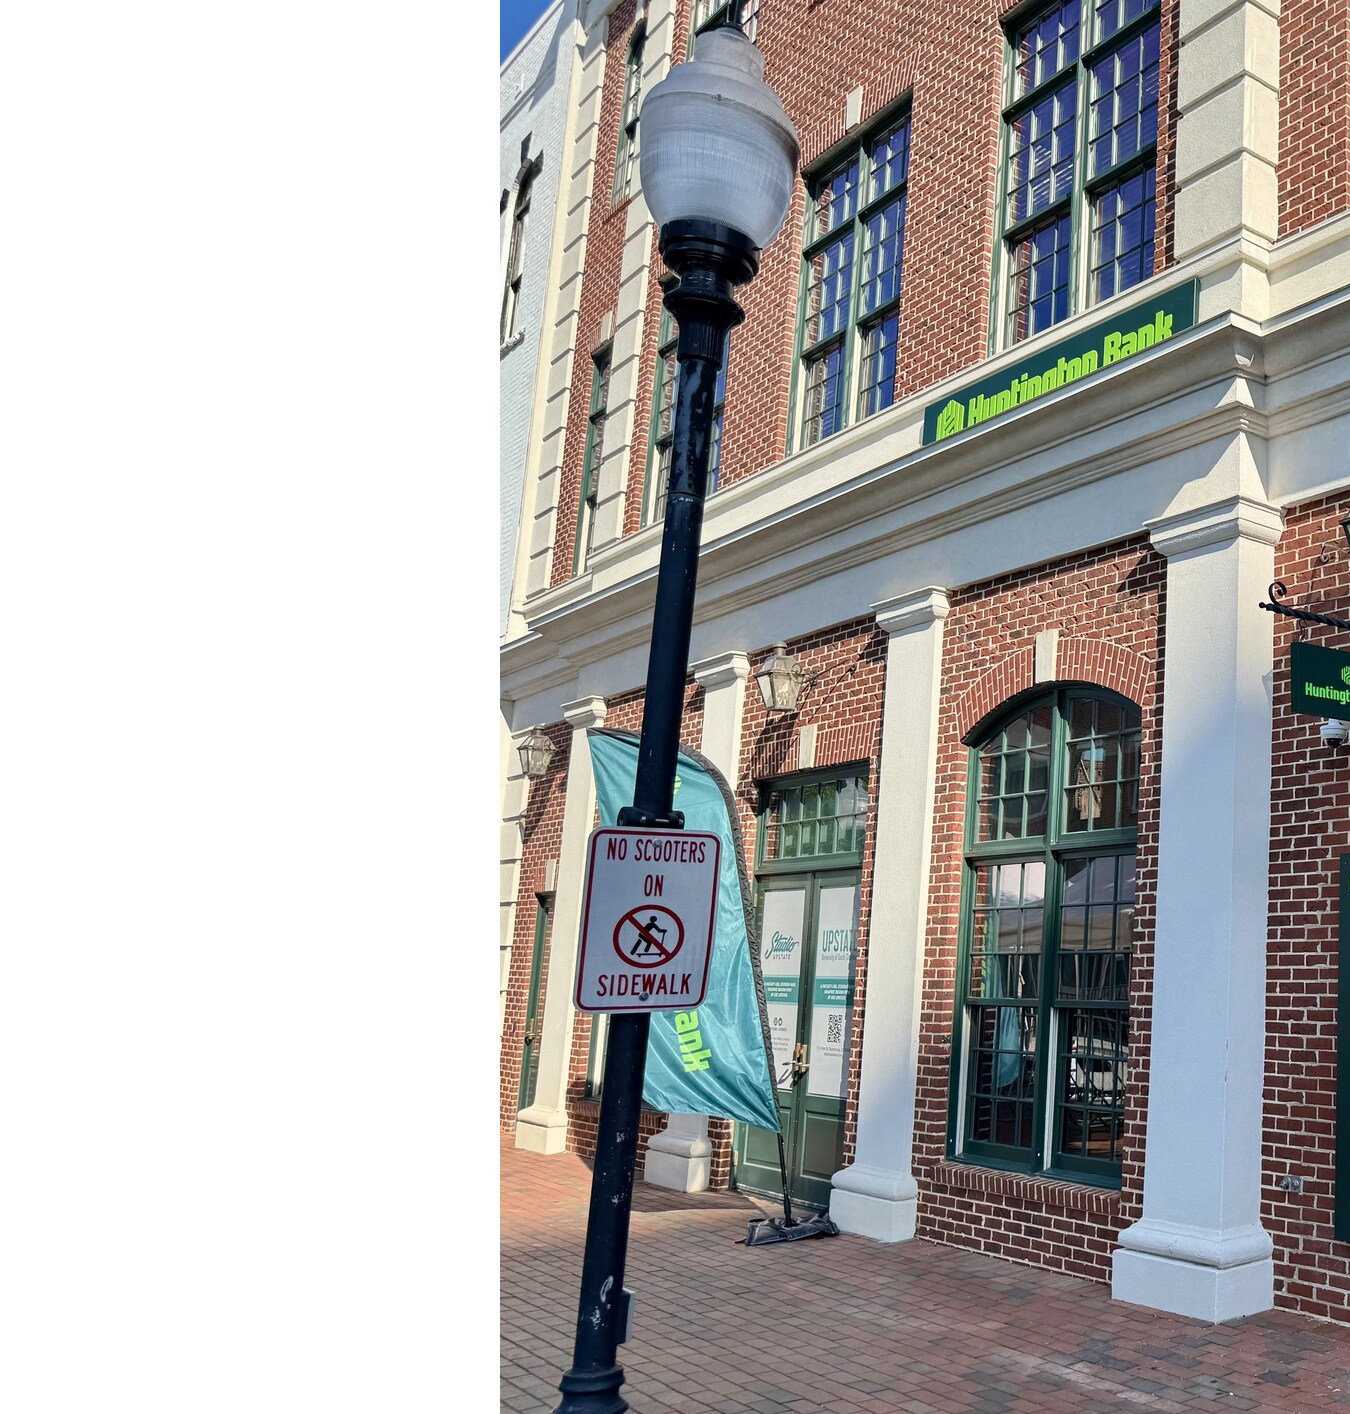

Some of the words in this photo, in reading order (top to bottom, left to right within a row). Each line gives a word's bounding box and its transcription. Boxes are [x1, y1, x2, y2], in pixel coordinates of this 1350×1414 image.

[1103, 310, 1173, 367] Bank
[607, 838, 628, 861] NO
[635, 839, 706, 864] SCOOTERS
[644, 874, 664, 897] ON
[765, 930, 799, 959] Studio
[597, 973, 692, 997] SIDEWALK
[674, 1010, 712, 1073] ank
